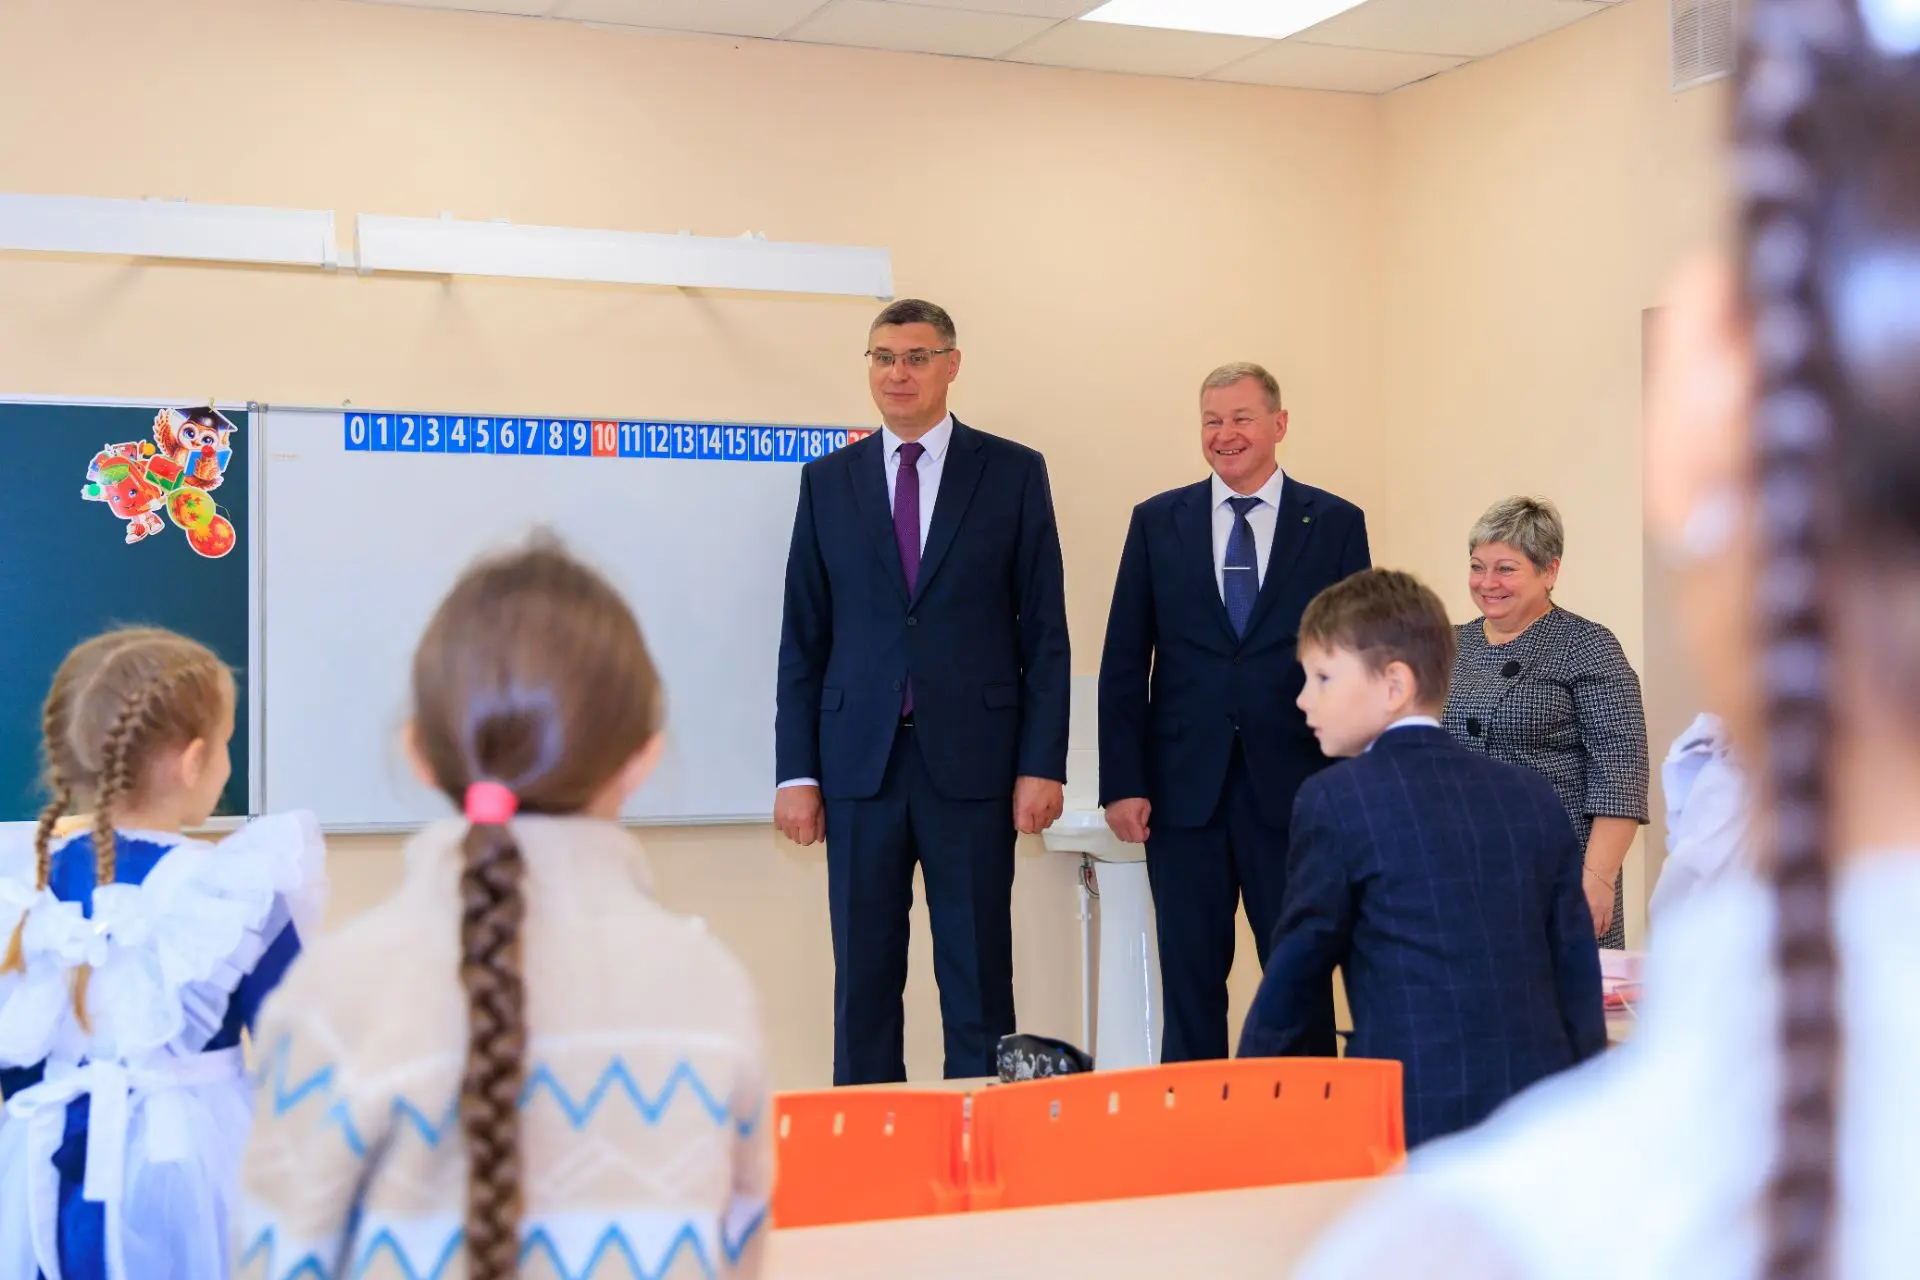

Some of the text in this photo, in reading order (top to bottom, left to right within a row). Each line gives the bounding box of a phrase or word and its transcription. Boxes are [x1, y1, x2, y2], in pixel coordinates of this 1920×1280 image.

[350, 415, 365, 445] 0
[376, 416, 388, 445] 1
[401, 417, 415, 446] 2
[426, 418, 440, 446] 3
[451, 418, 466, 447] 4
[476, 419, 490, 448] 5
[500, 420, 515, 448] 6
[525, 421, 539, 449] 7
[549, 421, 563, 450] 8
[573, 422, 587, 451] 9
[594, 423, 616, 451] 10
[621, 424, 641, 452] 11
[647, 425, 669, 453] 12
[673, 426, 695, 454] 13
[699, 427, 721, 454] 14
[725, 428, 746, 455] 15
[750, 428, 772, 456] 16
[775, 429, 797, 457] 17
[800, 430, 822, 458] 18
